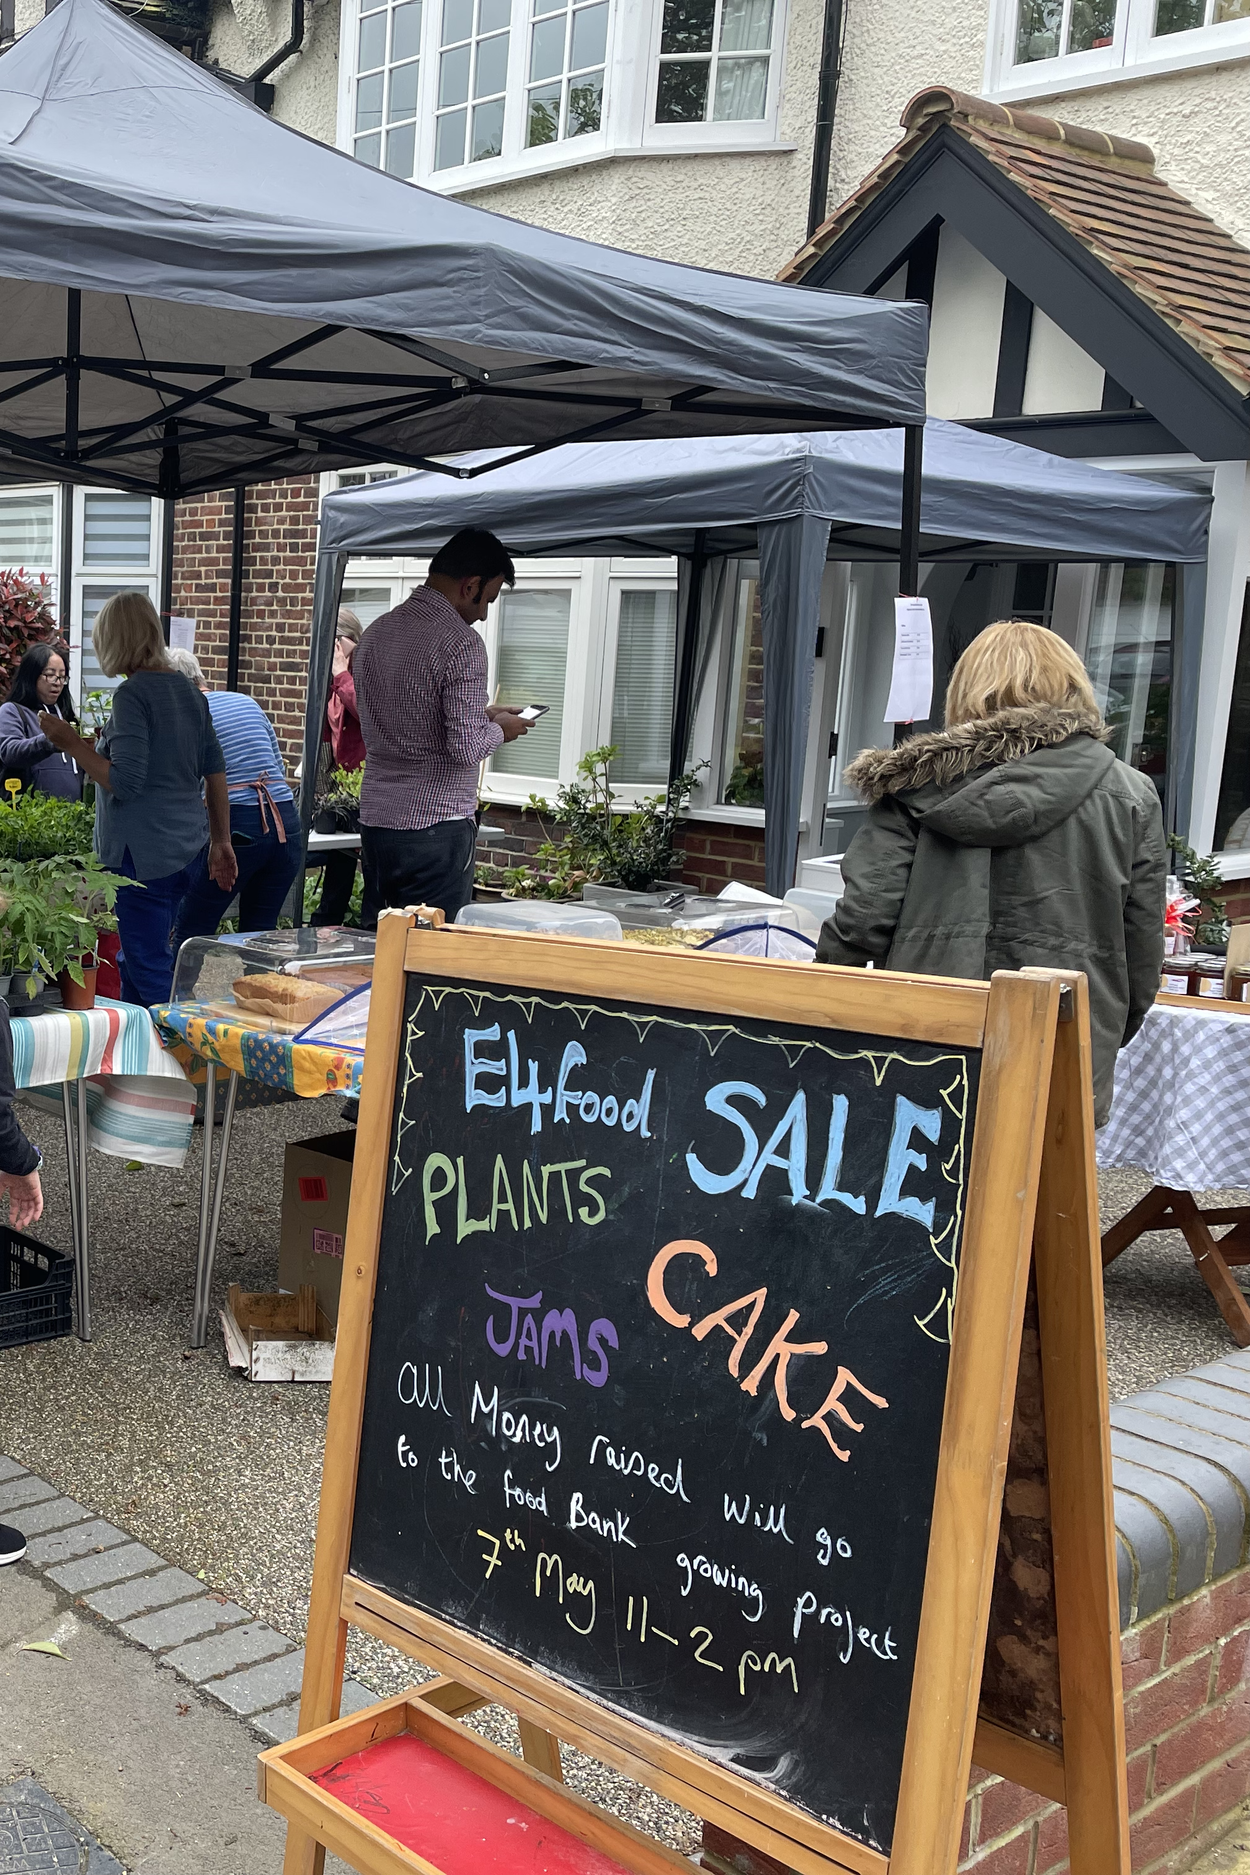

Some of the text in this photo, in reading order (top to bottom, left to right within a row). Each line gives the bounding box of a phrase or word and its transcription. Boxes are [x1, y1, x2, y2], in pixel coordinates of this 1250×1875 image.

[422, 1152, 612, 1246] PLANTS
[462, 1022, 943, 1233] E4food SALE
[484, 1282, 620, 1388] JAMS
[646, 1239, 890, 1463] CAKE
[397, 1434, 418, 1468] to
[437, 1446, 477, 1495] the
[503, 1468, 548, 1517] food
[565, 1491, 637, 1549] Bank
[675, 1552, 763, 1623] growing
[470, 1380, 561, 1472] Money
[589, 1434, 691, 1503] raised
[815, 1527, 853, 1566] go
[476, 1527, 526, 1580] 7th
[535, 1552, 596, 1635] May
[738, 1650, 799, 1696] pm
